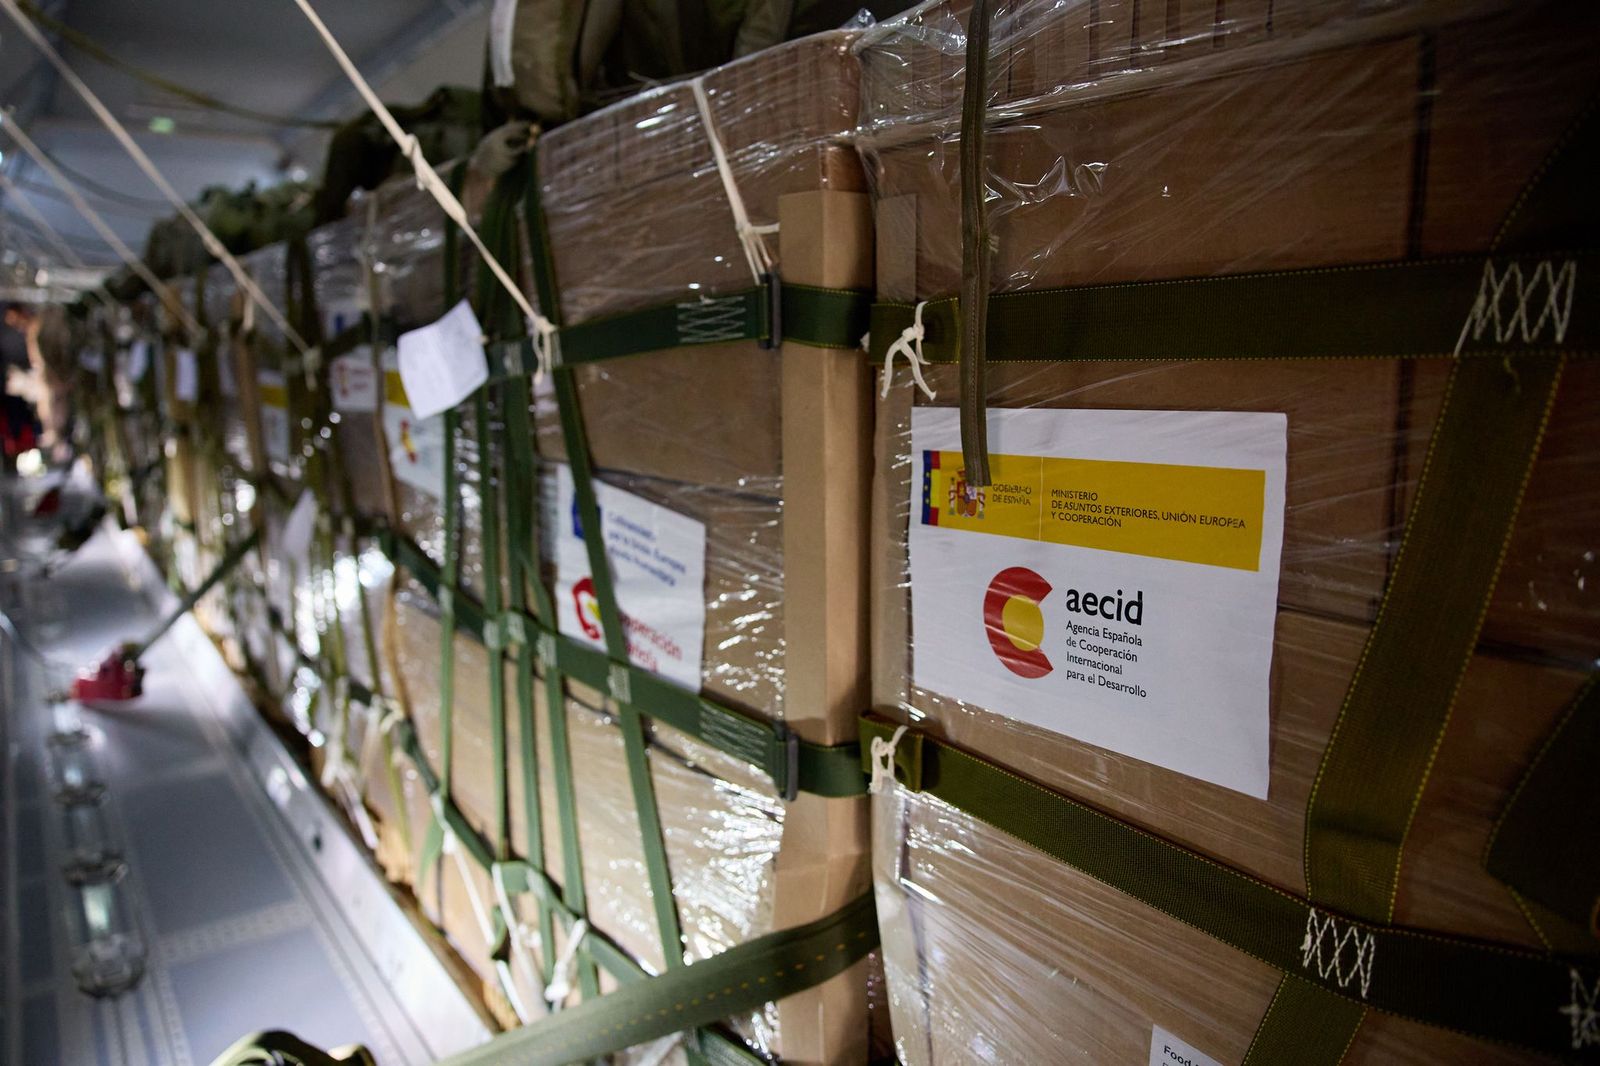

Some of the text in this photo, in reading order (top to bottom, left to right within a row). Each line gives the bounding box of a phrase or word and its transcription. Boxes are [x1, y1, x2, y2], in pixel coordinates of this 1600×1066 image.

[992, 493, 1032, 506] DE ESPAÑA
[1051, 488, 1098, 502] MINISTERIO
[1050, 511, 1122, 528] Y COOPERACIÓN
[1051, 500, 1246, 529] DE ASUNTOS EXTERIORES, UNIÓN EUROPEA
[1065, 588, 1143, 626] aecid
[1065, 619, 1143, 647] Agencia Española
[1065, 636, 1138, 662] de Cooperación
[1066, 651, 1123, 675] Internacional
[1066, 670, 1147, 698] para el Desarrollo
